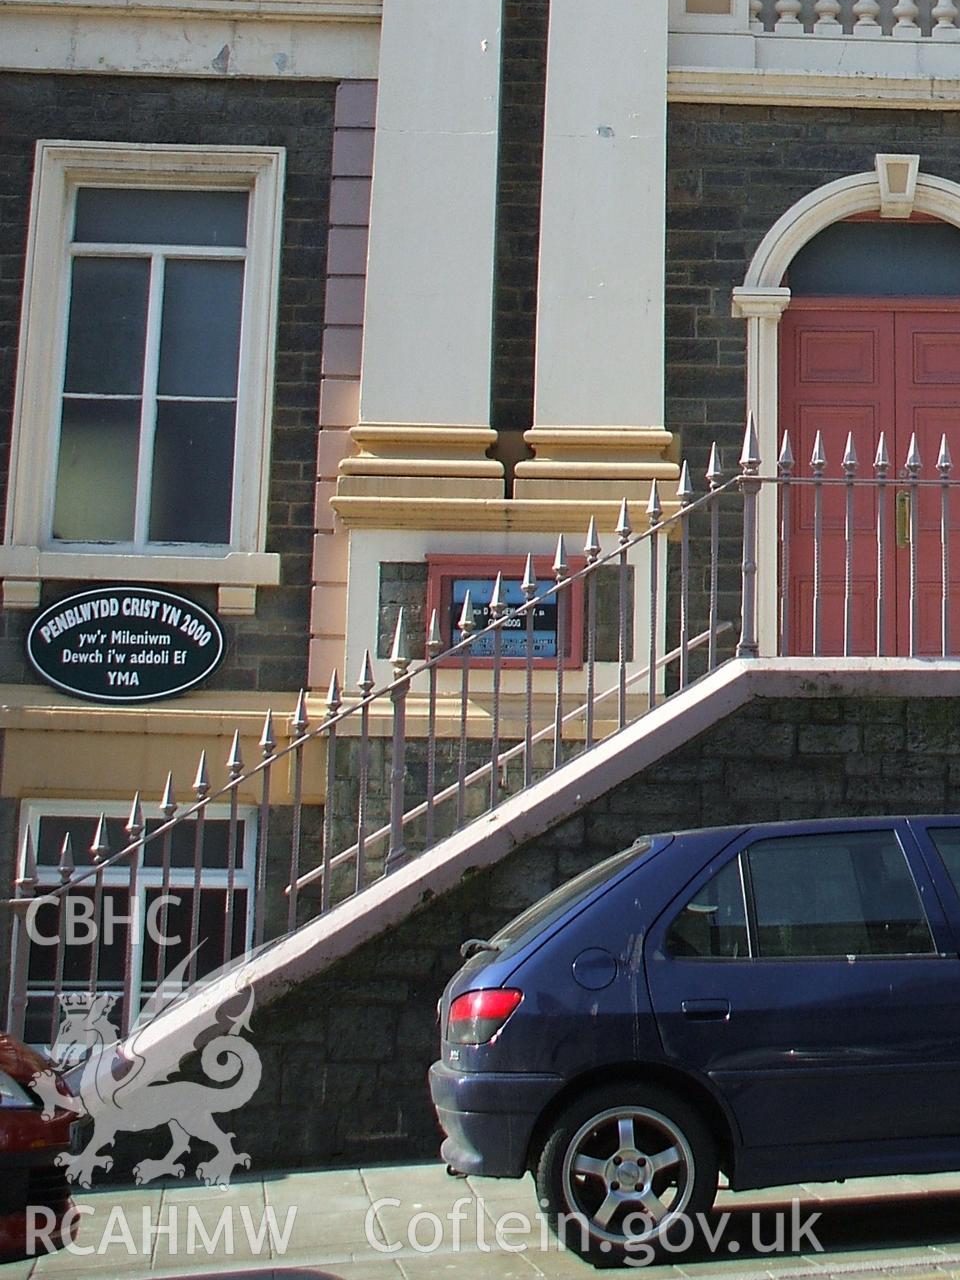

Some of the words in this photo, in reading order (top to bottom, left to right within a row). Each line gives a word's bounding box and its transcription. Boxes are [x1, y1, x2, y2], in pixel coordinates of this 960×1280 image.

[40, 598, 119, 644] PENBLWYDD
[122, 597, 160, 619] CRIST
[160, 603, 182, 627] YN
[180, 614, 212, 647] 2000
[79, 630, 107, 647] yw'r
[111, 630, 171, 645] Mileniwm
[63, 649, 102, 664] Dewch
[107, 649, 125, 664] i'w
[130, 650, 169, 664] addoli
[174, 650, 187, 664] Ef
[107, 671, 140, 686] YMA
